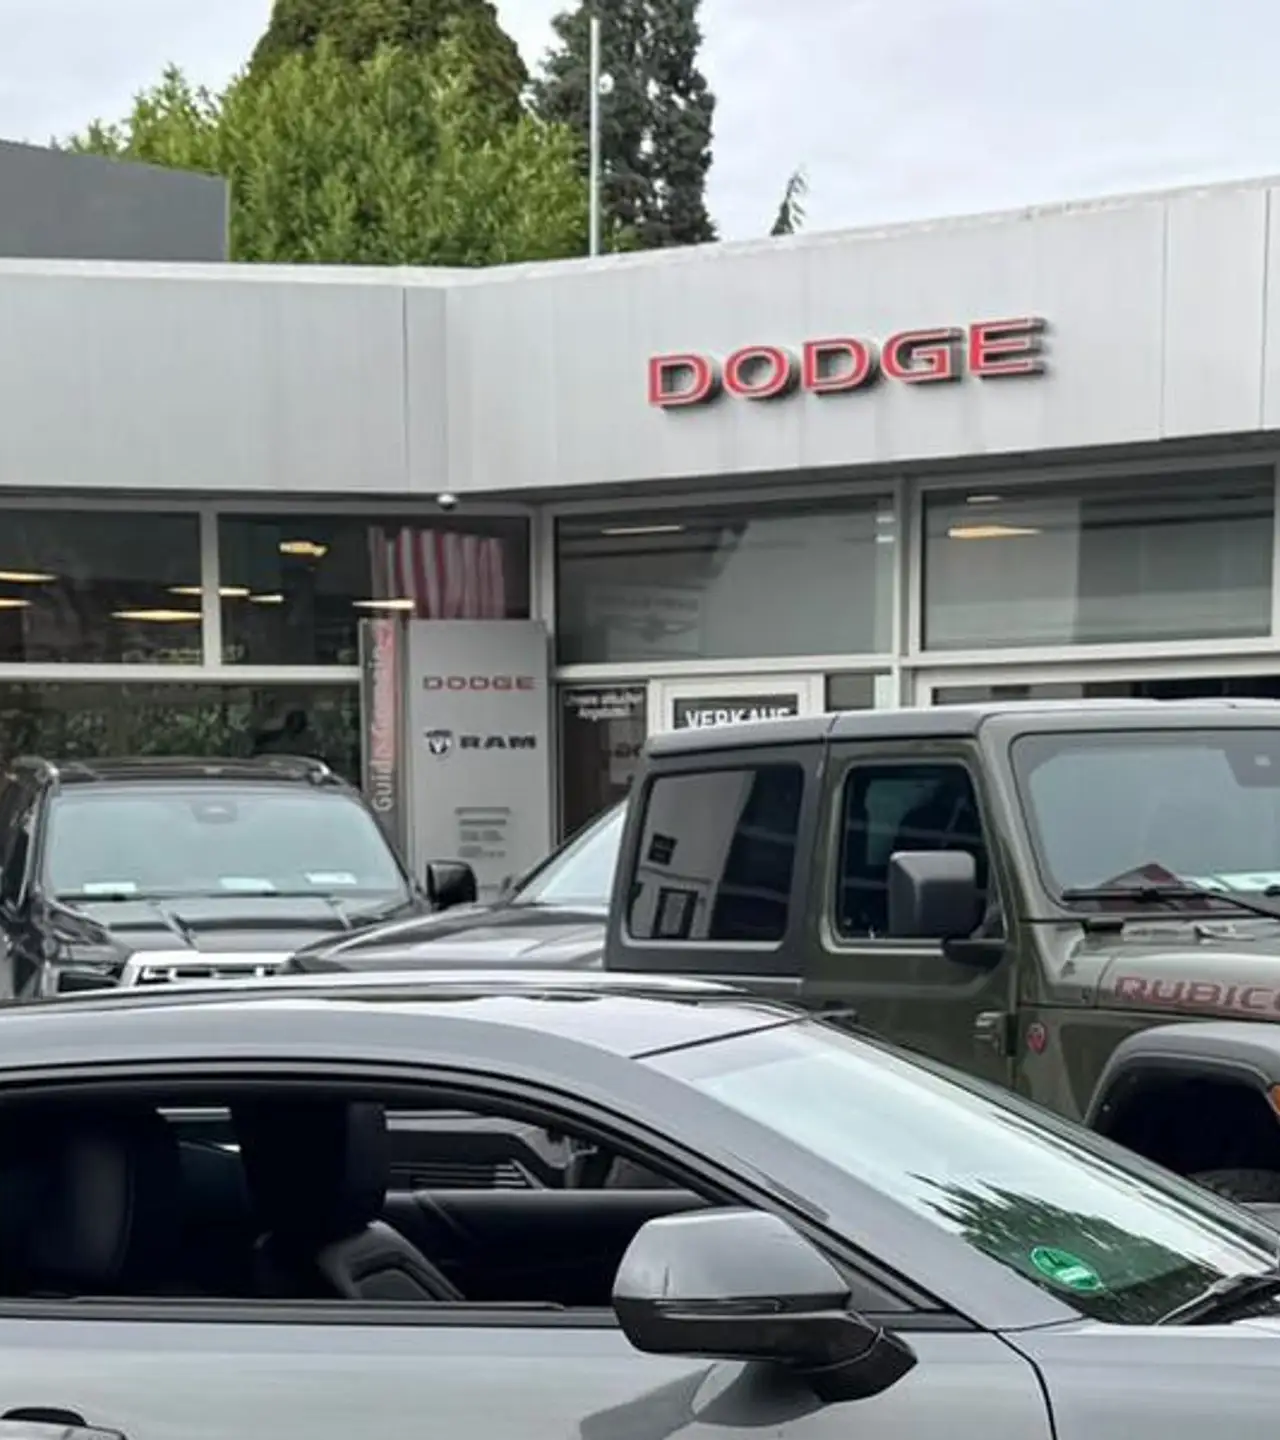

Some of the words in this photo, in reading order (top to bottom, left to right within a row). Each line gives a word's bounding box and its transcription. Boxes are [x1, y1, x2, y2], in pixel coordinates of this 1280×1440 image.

[648, 317, 1046, 408] DODGE
[423, 676, 536, 690] DODGE
[460, 735, 536, 749] RAM
